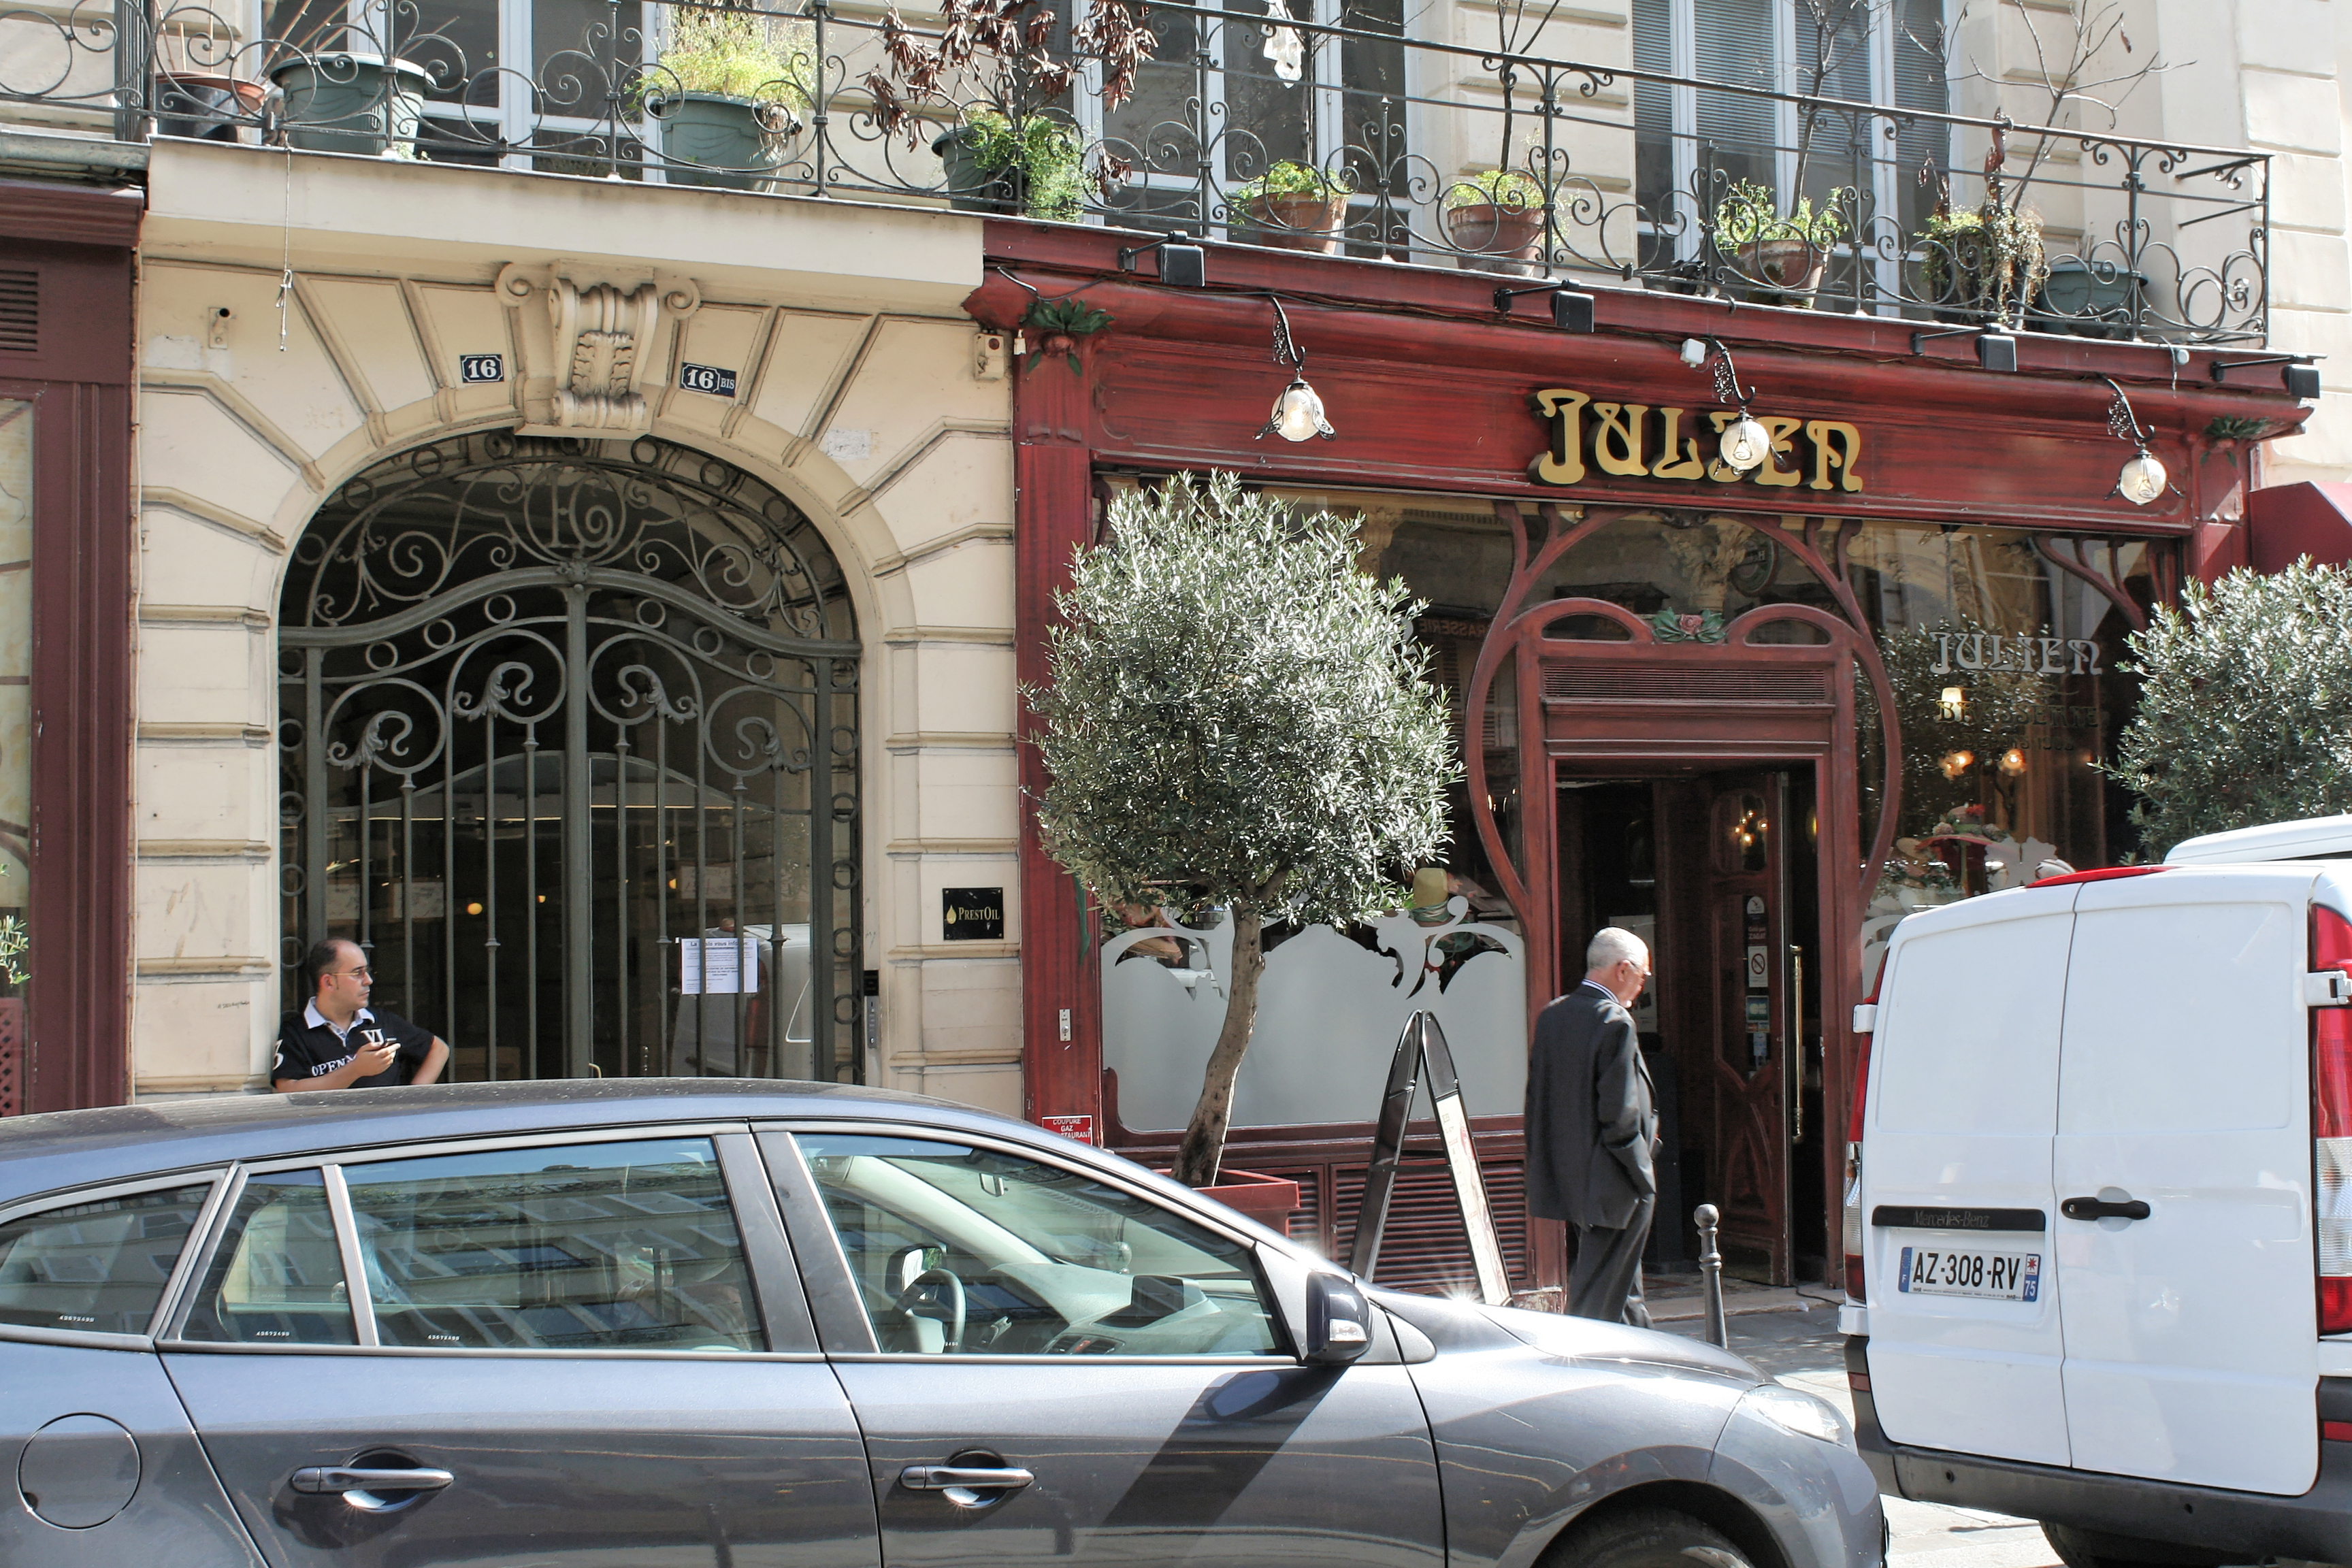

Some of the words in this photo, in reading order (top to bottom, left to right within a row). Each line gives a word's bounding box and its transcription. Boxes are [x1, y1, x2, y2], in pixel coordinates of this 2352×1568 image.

[468, 359, 497, 378] 16
[687, 369, 714, 389] 16
[720, 378, 734, 389] BIS
[1928, 631, 2103, 675] JULIEN
[1913, 1210, 1991, 1228] Mercedes-Benz
[2025, 1280, 2036, 1296] 75
